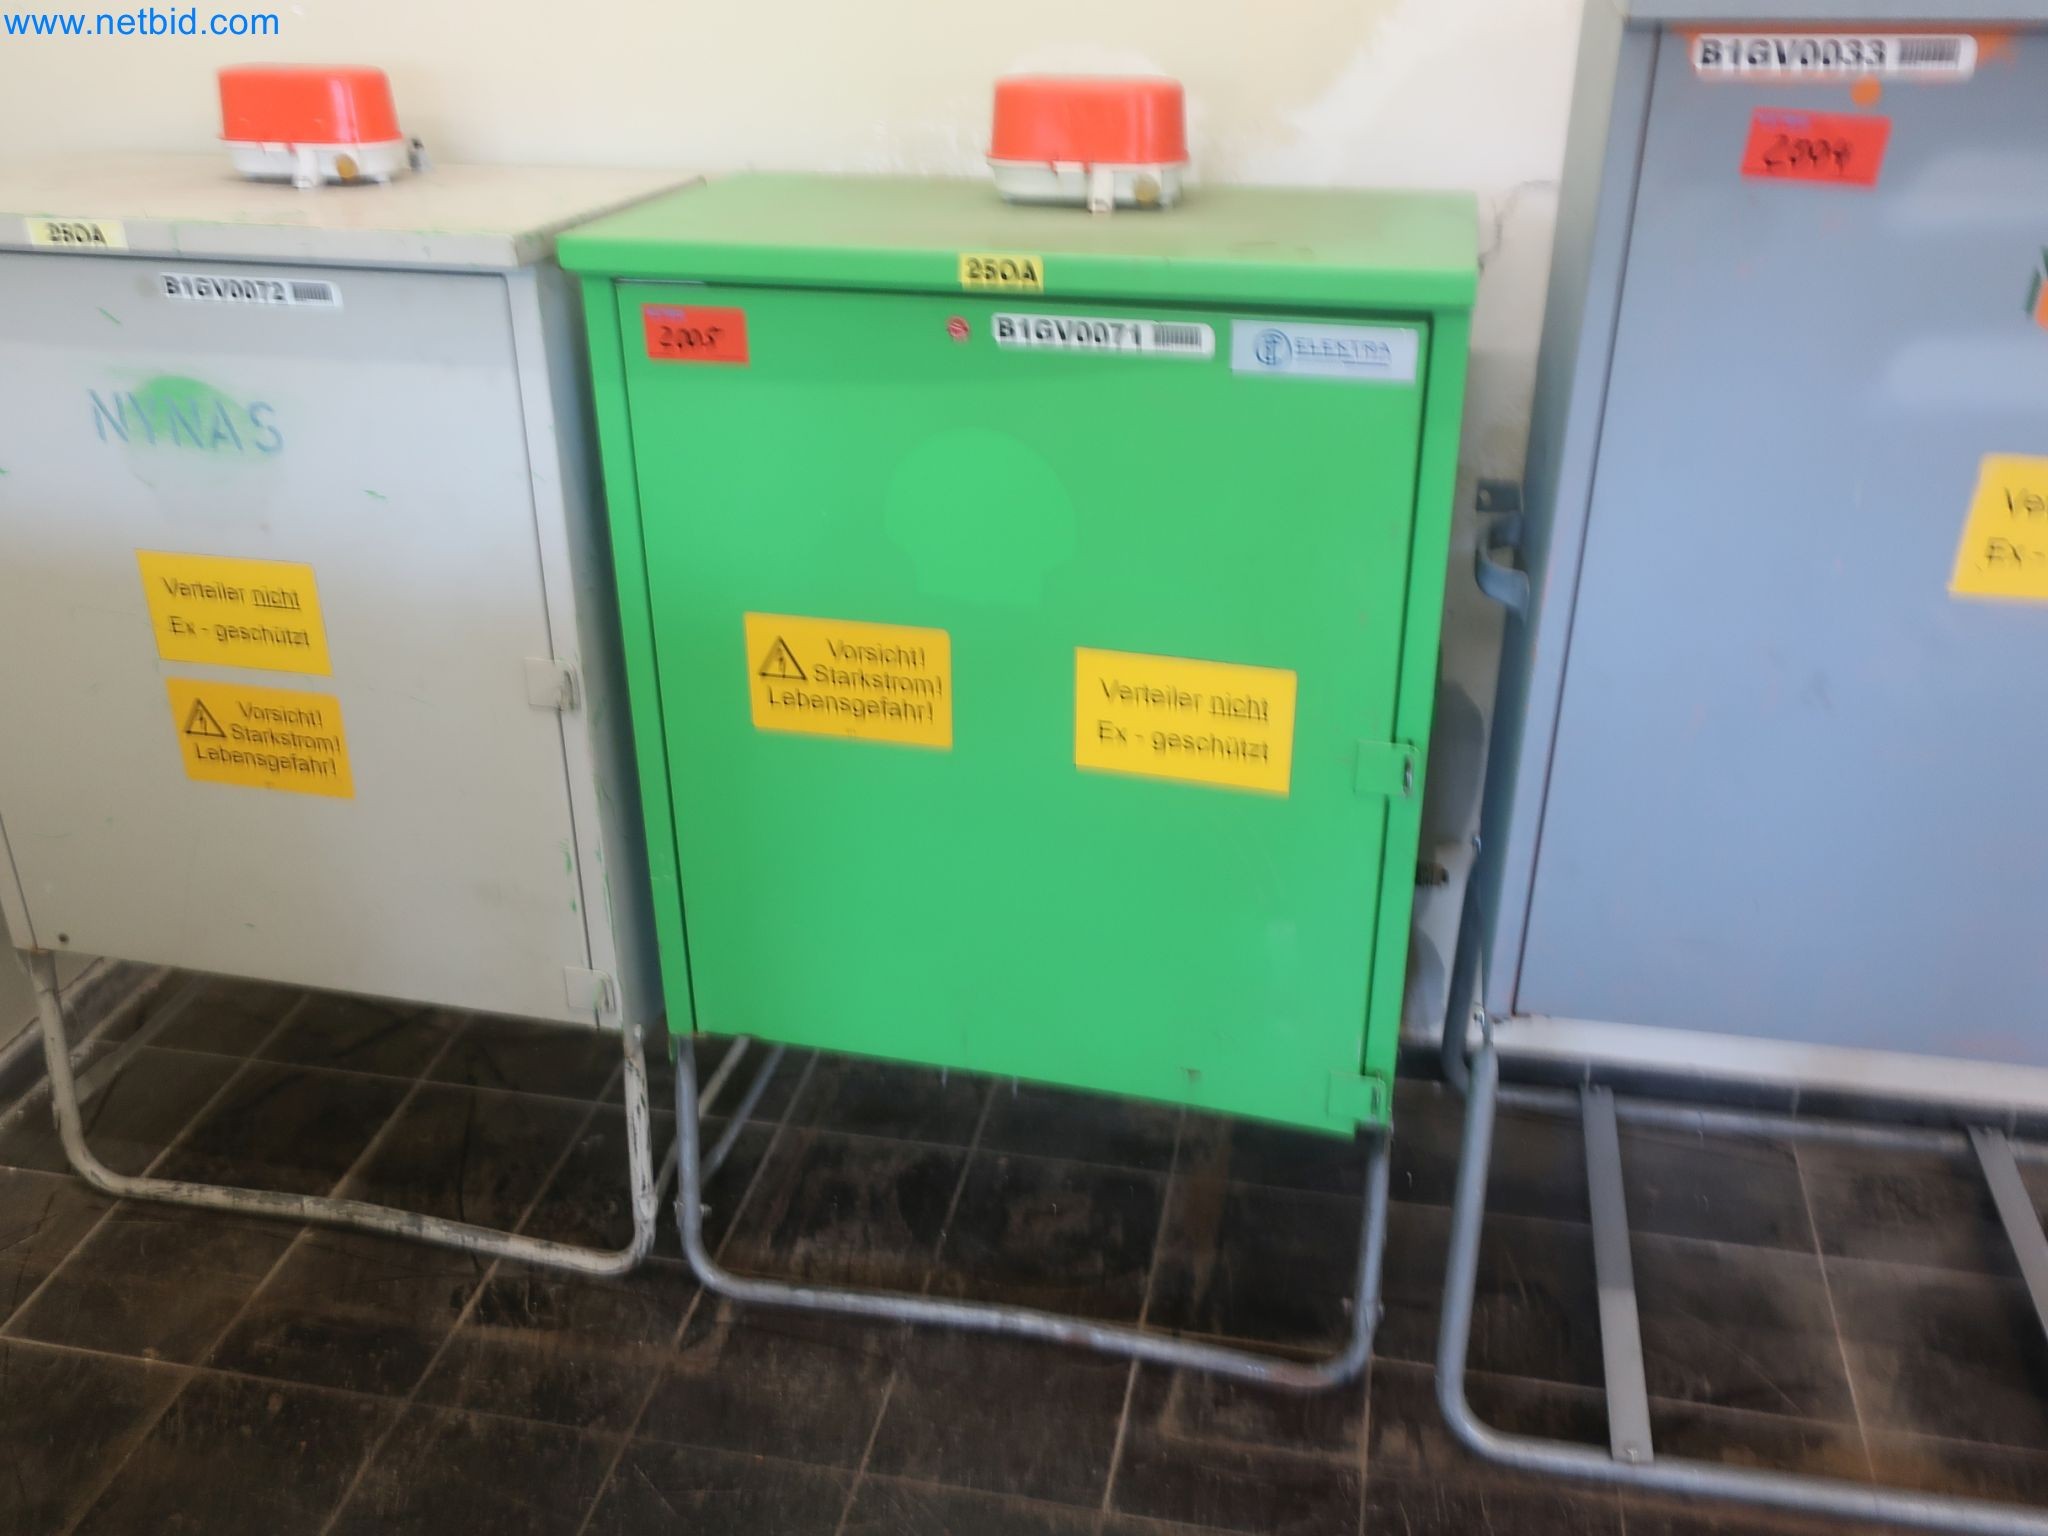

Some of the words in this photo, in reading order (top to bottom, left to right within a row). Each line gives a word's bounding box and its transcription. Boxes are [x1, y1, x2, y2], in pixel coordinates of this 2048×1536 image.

[1700, 37, 1887, 66] B1GV0033
[162, 275, 286, 302] B1GV0072
[997, 315, 1143, 346] B1GV0071
[163, 576, 245, 605] Verteiler
[252, 585, 301, 612] nicht
[170, 615, 196, 637] Ex
[215, 621, 311, 648] geschützt
[827, 638, 926, 667] Vorsicht!
[813, 663, 943, 697] Starkstrom!
[238, 701, 323, 729] Vorsicht!
[769, 687, 933, 723] Lebensgefahr!
[1099, 678, 1203, 714] Verteiler
[1208, 691, 1270, 722] nicht
[230, 723, 341, 754] Starkstrom!
[1098, 720, 1128, 743] Ex
[1150, 728, 1270, 765] geschützt
[195, 743, 338, 778] Lebensgefahr!
